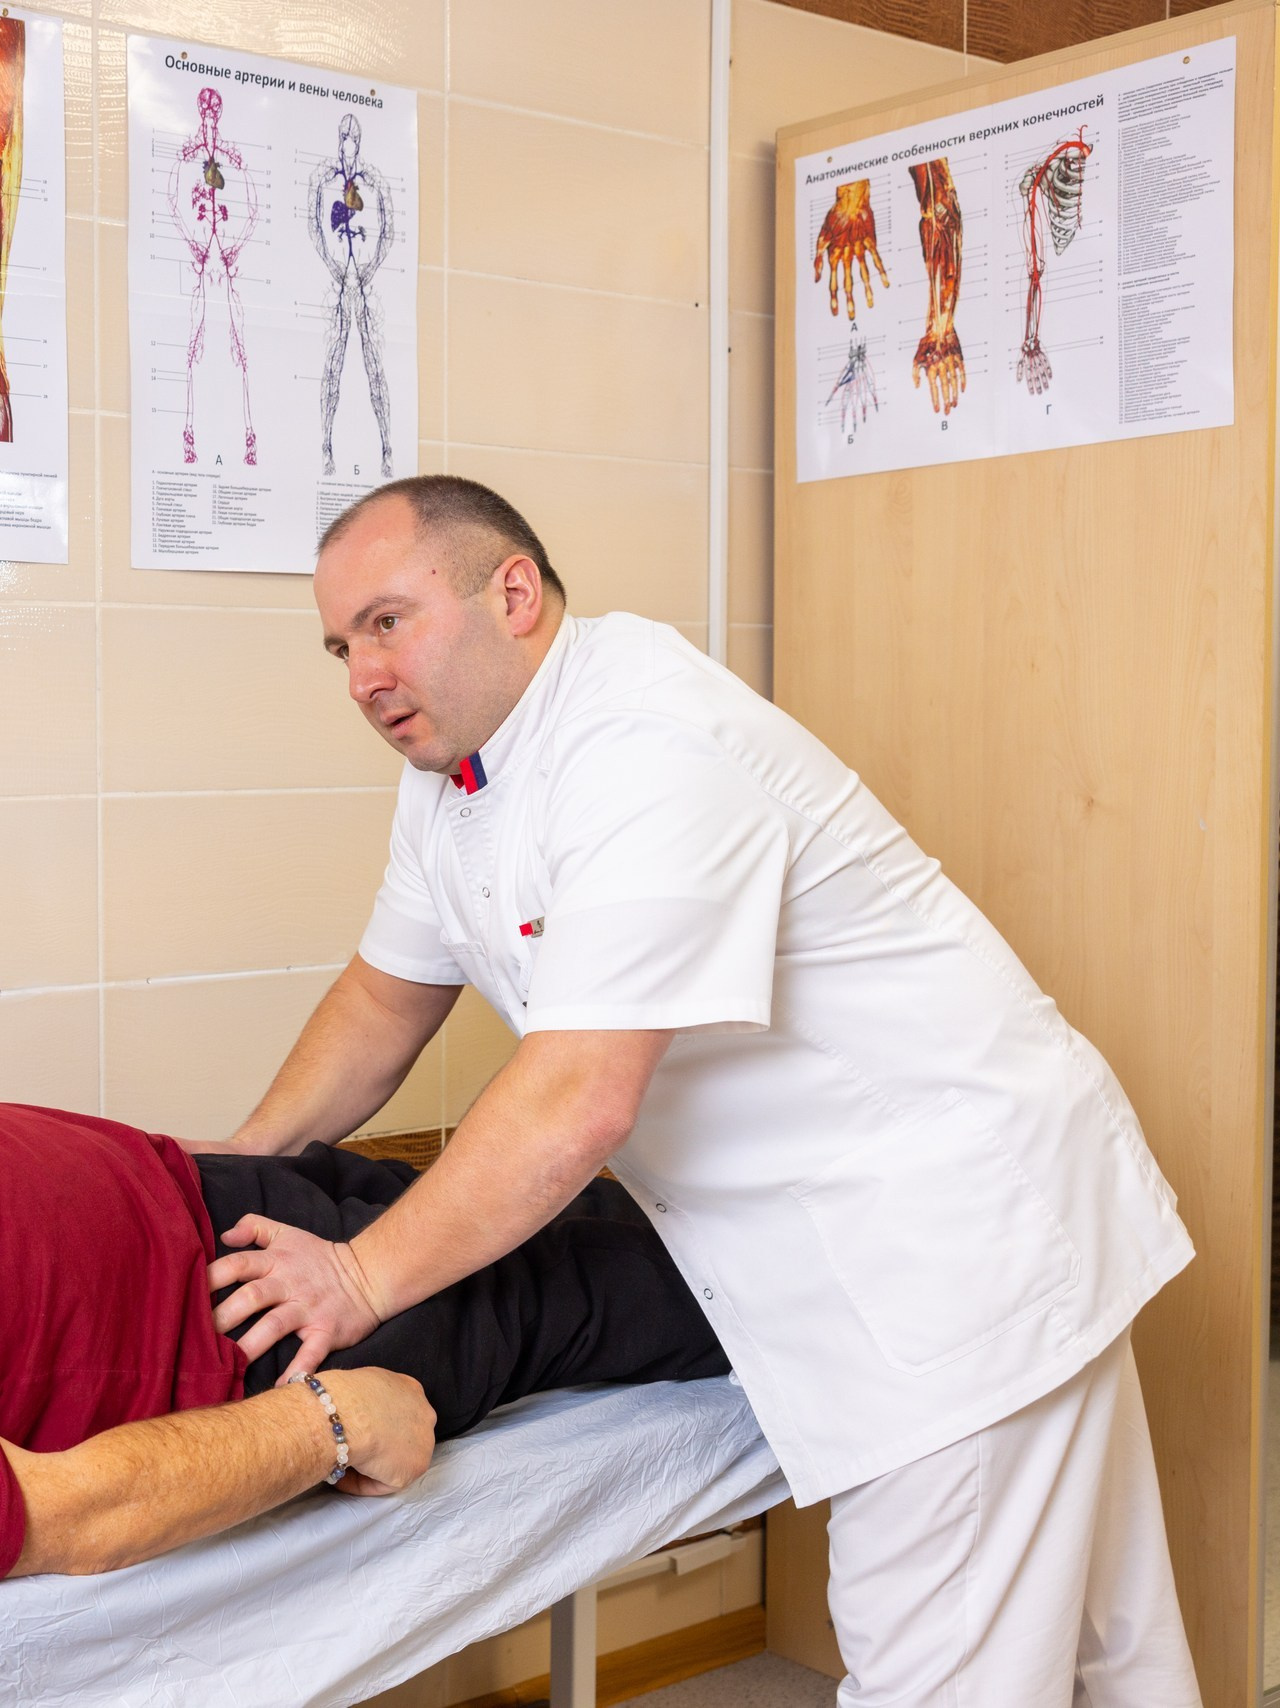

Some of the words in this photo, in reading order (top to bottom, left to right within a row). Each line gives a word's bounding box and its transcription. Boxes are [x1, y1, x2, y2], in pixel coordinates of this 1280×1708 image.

[165, 55, 231, 79] Основные
[235, 71, 284, 89] артерии
[288, 81, 296, 91] и
[300, 83, 329, 98] вены
[332, 90, 383, 108] человека
[806, 155, 888, 185] Анатомические
[892, 134, 965, 162] особенности
[970, 120, 1019, 142] верхних
[1023, 95, 1104, 127] конечностей
[850, 322, 858, 332] А
[1046, 404, 1052, 415] Г
[941, 421, 948, 430] В
[847, 434, 854, 444] Б
[216, 455, 223, 465] А
[354, 465, 361, 475] Б
